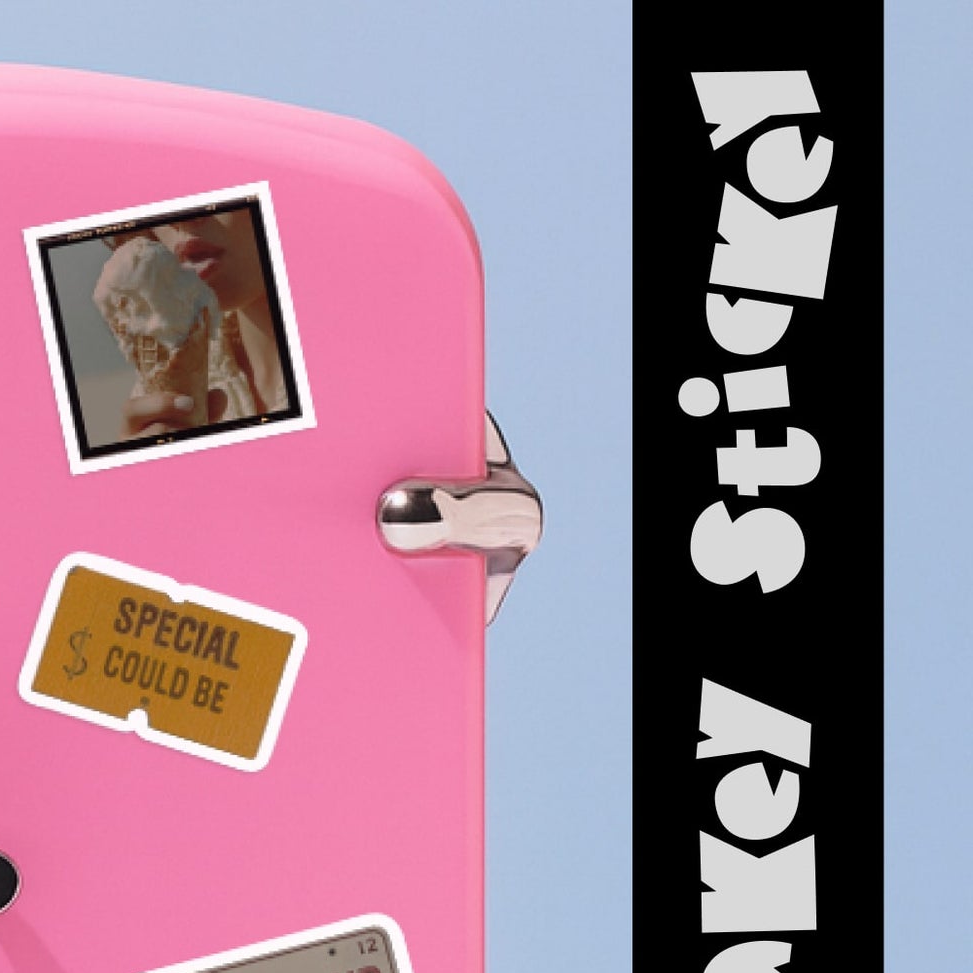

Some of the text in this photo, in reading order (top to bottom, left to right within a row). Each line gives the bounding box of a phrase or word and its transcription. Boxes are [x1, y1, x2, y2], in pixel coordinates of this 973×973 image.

[62, 626, 93, 680] $
[113, 597, 240, 671] SPECIAL
[103, 645, 230, 714] COULD BE
[357, 938, 379, 955] 12
